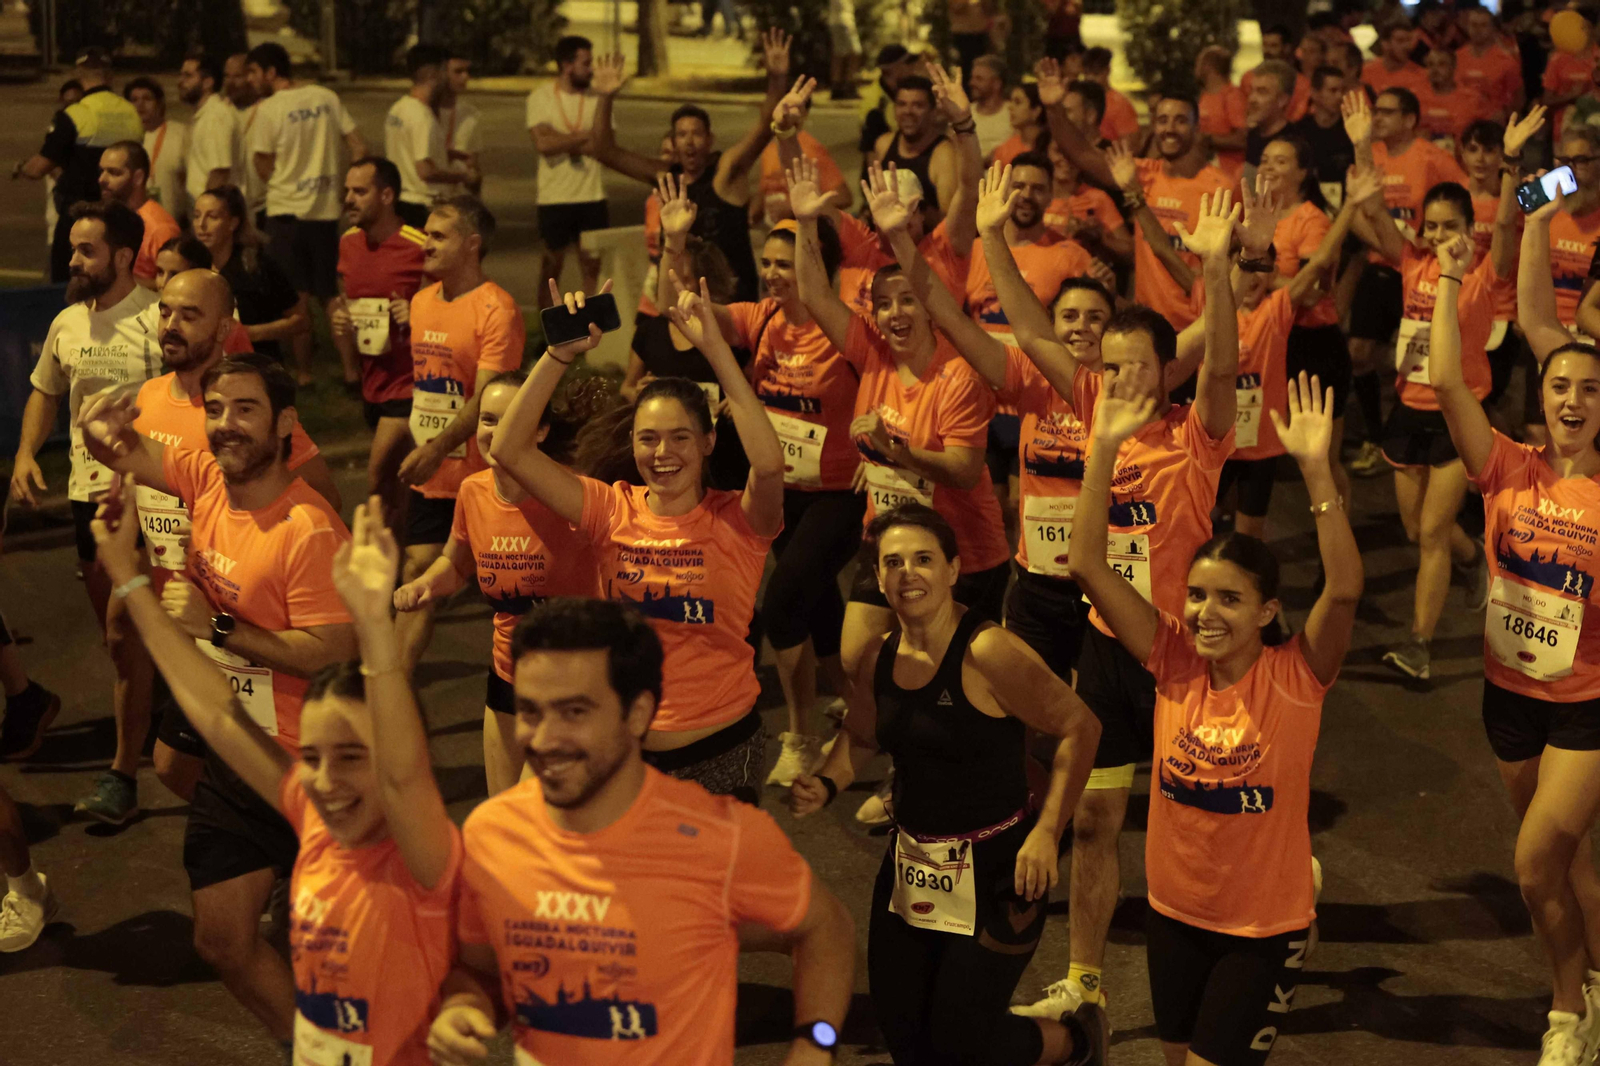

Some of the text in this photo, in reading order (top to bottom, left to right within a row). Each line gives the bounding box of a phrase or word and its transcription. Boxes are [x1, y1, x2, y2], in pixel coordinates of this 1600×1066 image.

[419, 414, 448, 429] 2797
[1537, 498, 1586, 523] XXXV
[1517, 514, 1597, 545] GUADALQUIVIR
[1552, 518, 1599, 536] NOCTURNA
[490, 535, 531, 552] XXXV
[621, 553, 704, 567] GUADALQUIVIR
[654, 548, 703, 557] NOCTURNA
[482, 560, 545, 571] GUADALQUIVIR
[1503, 613, 1558, 647] 18646
[534, 890, 611, 922] XXXV
